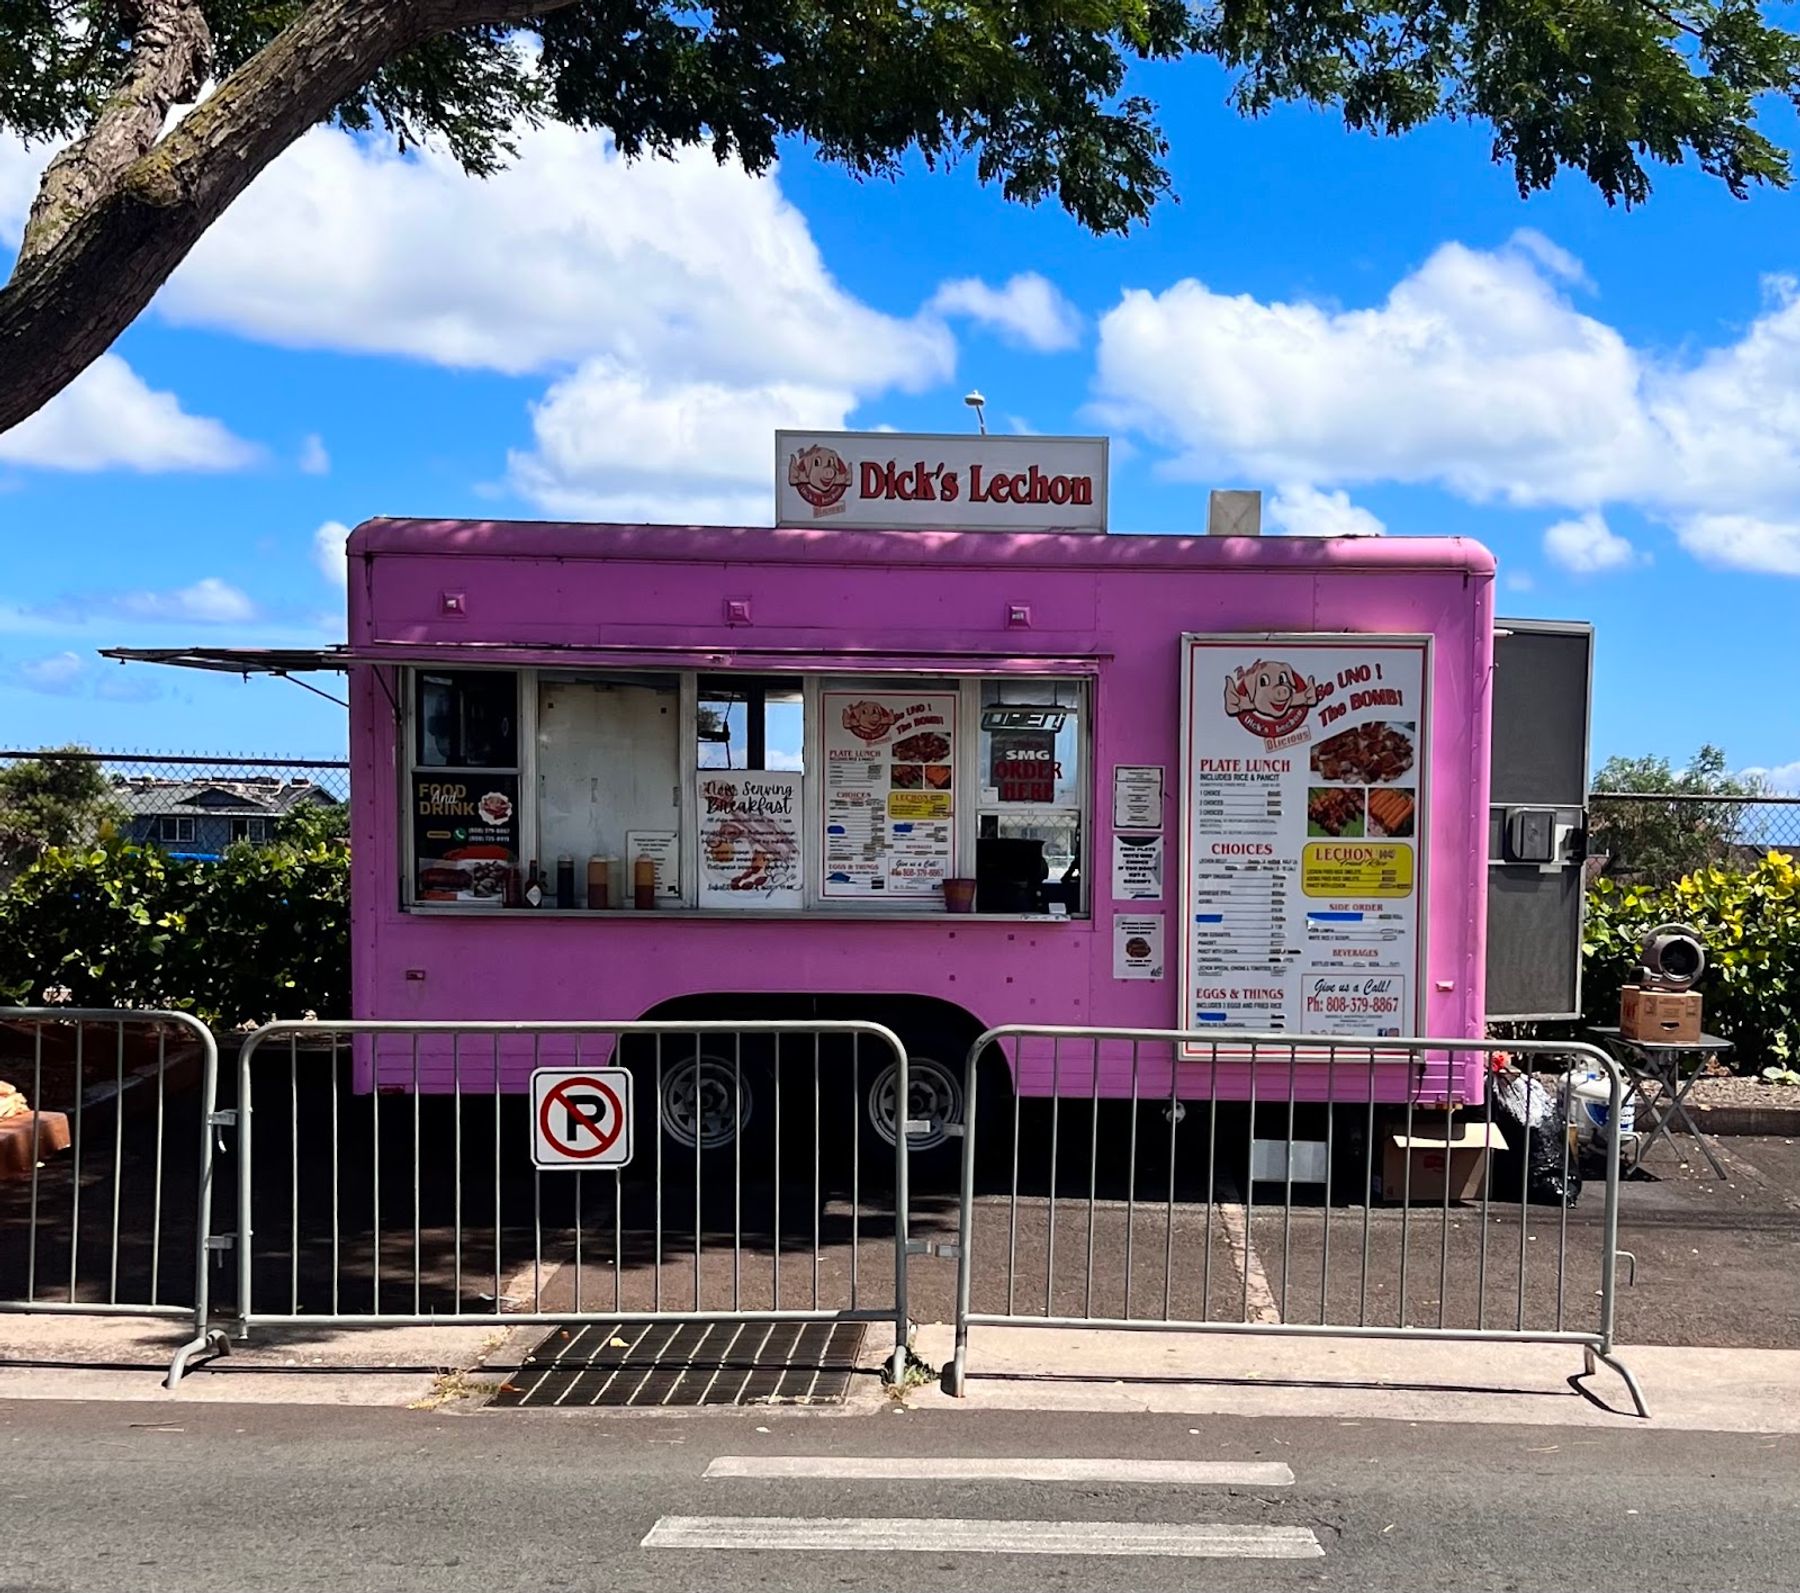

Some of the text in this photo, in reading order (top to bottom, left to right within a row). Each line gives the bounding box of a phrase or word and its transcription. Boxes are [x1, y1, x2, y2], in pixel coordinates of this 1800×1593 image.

[860, 459, 959, 501] Dick's
[969, 464, 1093, 505] Lechon
[1337, 664, 1371, 688] UNO
[1375, 663, 1382, 680] !
[1318, 689, 1403, 727] The BOMB!
[1006, 749, 1050, 760] SMG
[1200, 759, 1290, 773] PLATE LUNCH
[1200, 773, 1232, 781] INCLUDES
[1233, 773, 1248, 781] RICE
[418, 784, 467, 798] FOOD
[430, 789, 458, 804] And
[742, 781, 793, 798] Serving
[419, 801, 475, 815] DRINK
[705, 797, 793, 816] Breakfast
[1211, 843, 1273, 855] CHOICES
[1315, 848, 1373, 861] LECHON
[1329, 903, 1383, 911] SIDE ORDER
[1332, 949, 1378, 957] BEVERAGES
[1196, 988, 1284, 1000] EGGS & THINGS
[1314, 978, 1391, 997] Give us a Call!
[1307, 996, 1399, 1012] Ph: 808-379-8867
